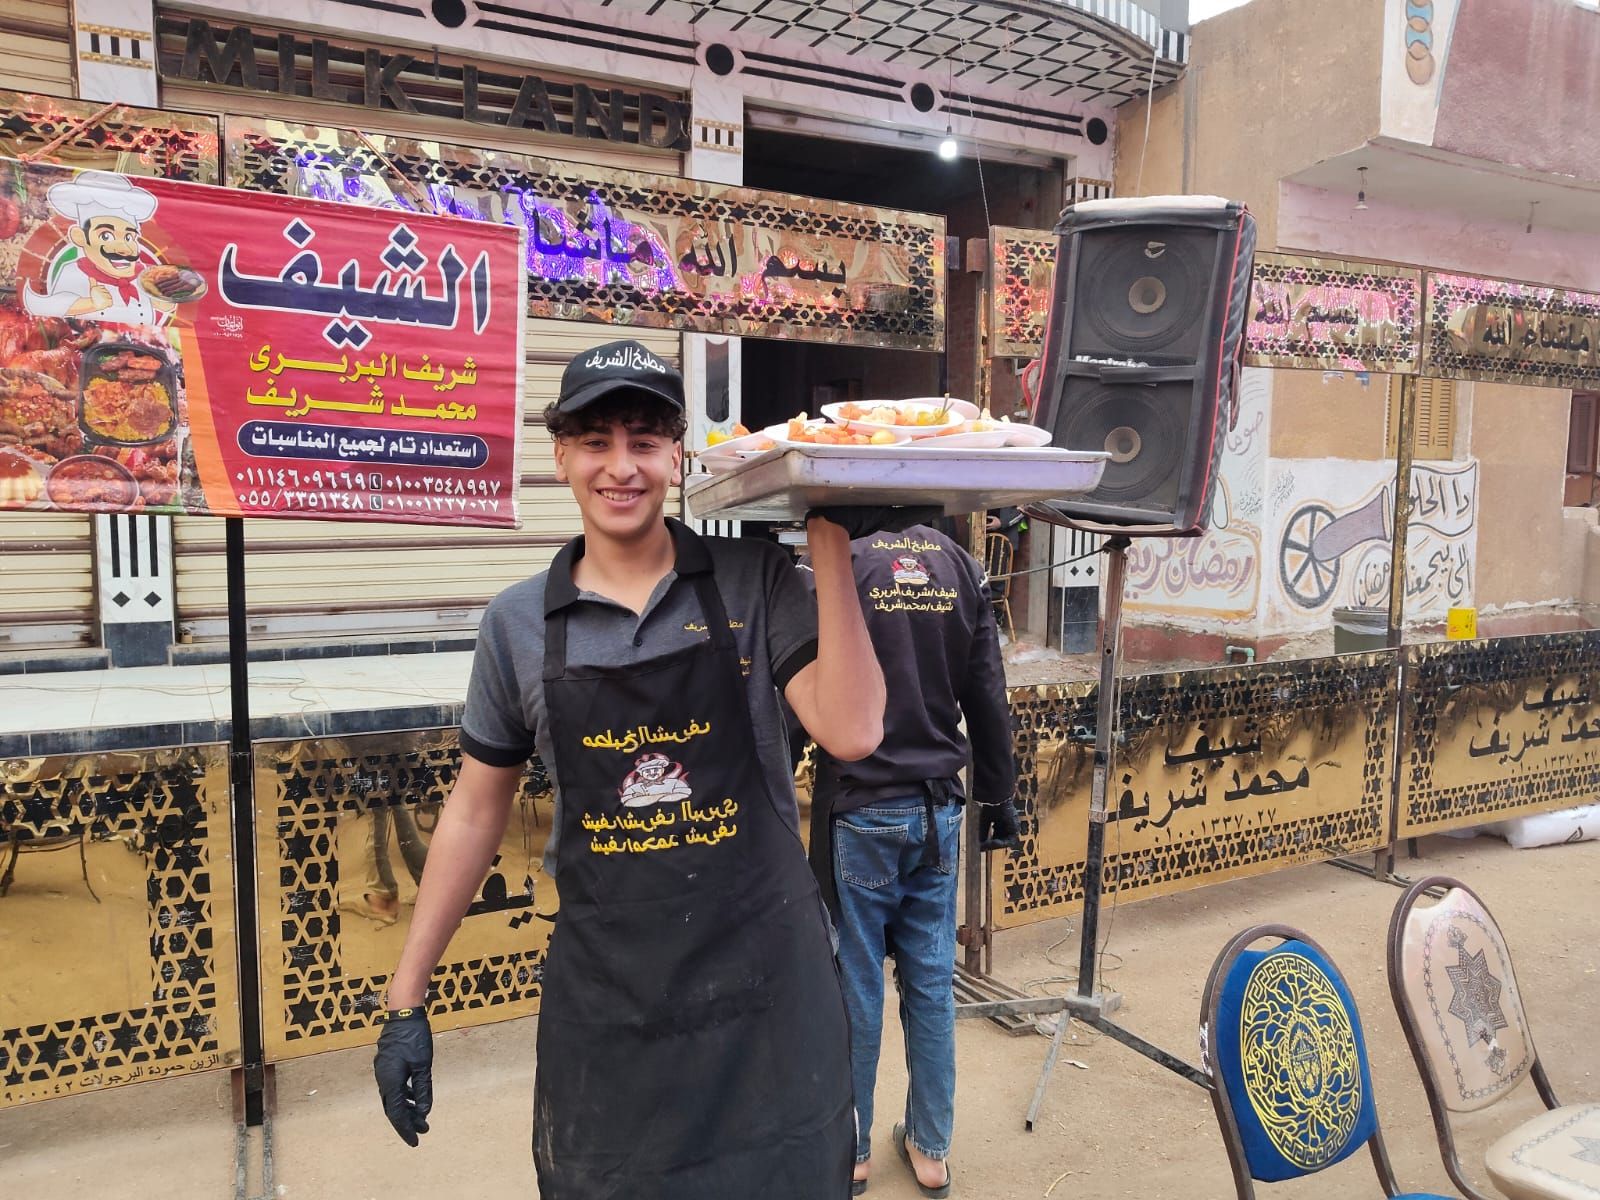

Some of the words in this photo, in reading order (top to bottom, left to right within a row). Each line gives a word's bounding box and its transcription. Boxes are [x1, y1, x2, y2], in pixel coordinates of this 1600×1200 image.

[180, 18, 420, 114] MILK
[463, 64, 682, 149] LAND
[532, 207, 654, 267] ماشا
[218, 217, 491, 350] الشيف
[585, 346, 632, 369] الشريف
[631, 347, 666, 374] مطبخ
[403, 354, 478, 391] شريف
[246, 377, 385, 418] شريف
[390, 393, 478, 421] محمد
[251, 426, 335, 452] المناسبات
[338, 435, 386, 457] لجميع
[389, 438, 416, 458] تام
[420, 440, 477, 459] استعداد
[871, 537, 911, 550] الشريف
[911, 540, 942, 553] مطبخ
[1165, 717, 1262, 770] شيف
[1469, 714, 1551, 765] شريف
[1224, 766, 1310, 802] محمد
[189, 1054, 220, 1071] الزين
